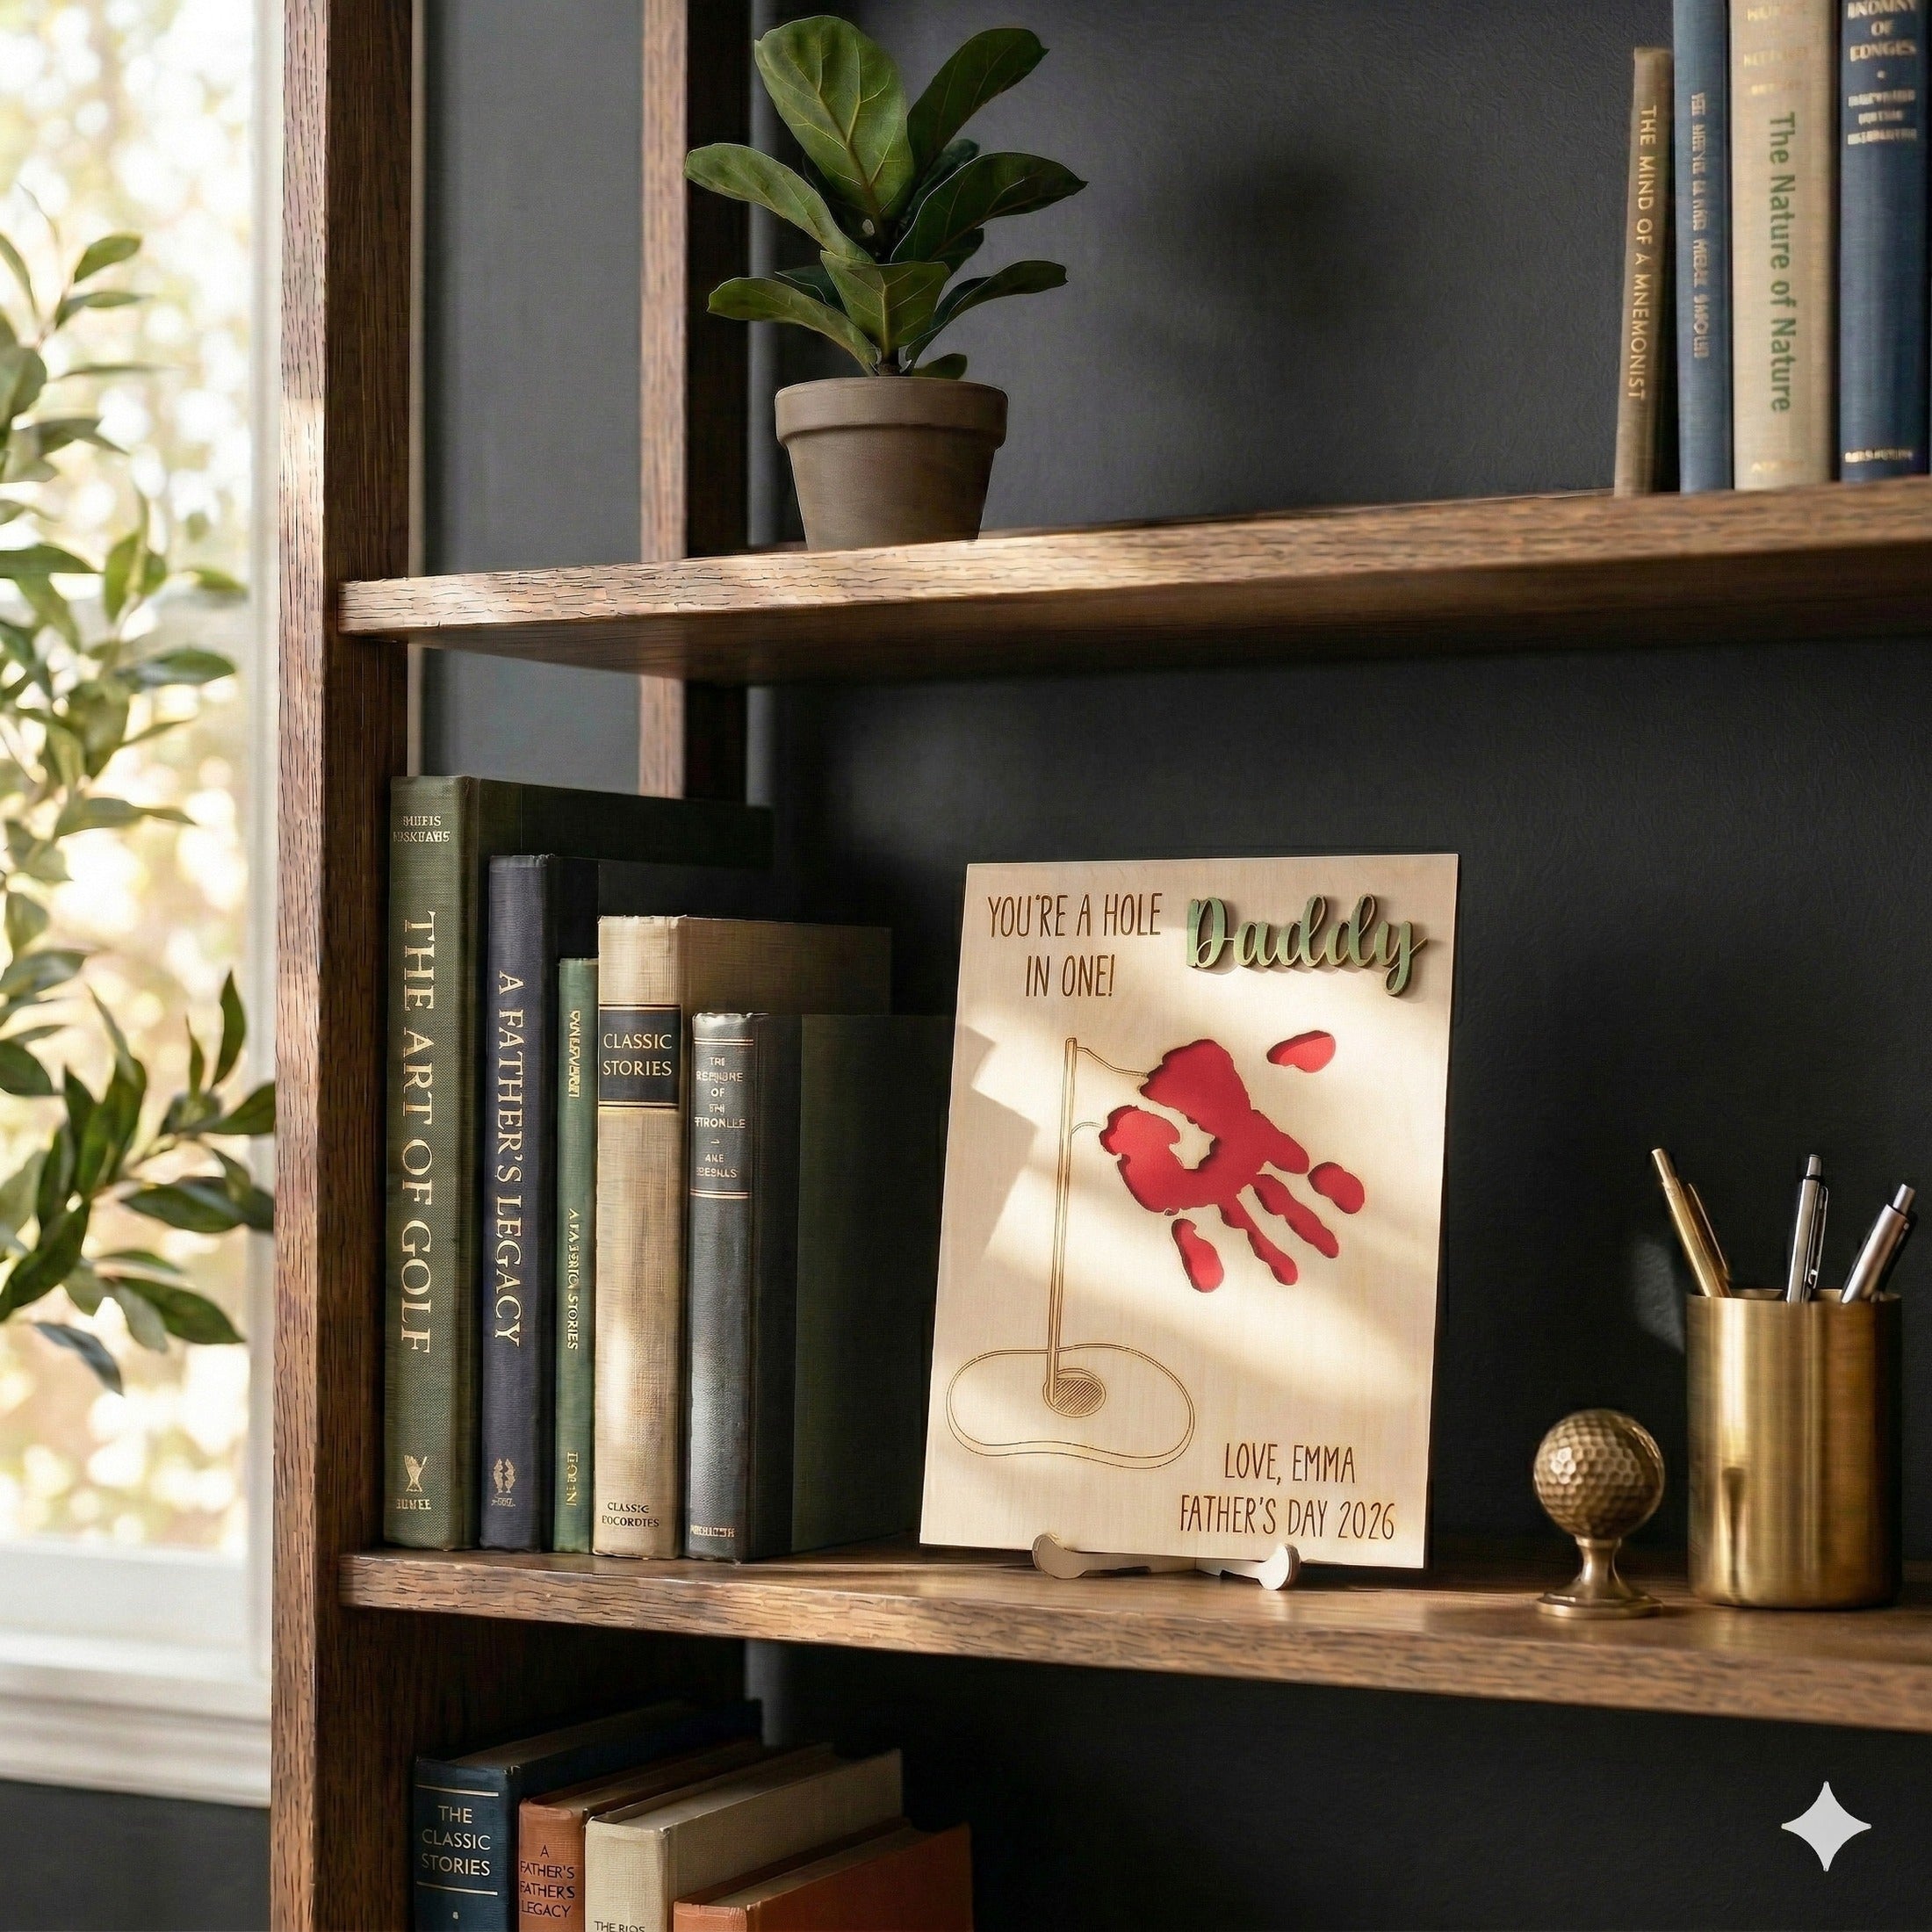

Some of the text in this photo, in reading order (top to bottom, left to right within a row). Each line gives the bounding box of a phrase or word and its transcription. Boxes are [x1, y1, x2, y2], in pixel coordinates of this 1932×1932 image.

[1770, 112, 1796, 164] The
[1770, 174, 1796, 268] Nature
[1628, 105, 1658, 400] THE MIND OF A MNEMONIST
[1771, 278, 1797, 308] of
[1771, 317, 1797, 413] Nature
[988, 892, 1164, 938] YOU'RE A HOLE
[1186, 894, 1428, 998] Daddy
[1026, 954, 1116, 998] IN ONE!
[603, 1033, 673, 1050] CLASSIC
[603, 1059, 673, 1077] STORIES
[710, 1088, 724, 1097] OF
[400, 911, 436, 1353] THE ART OF GOLF
[494, 970, 524, 1347] A FATHER'S LEGACY
[566, 1294, 579, 1351] STORIES
[1224, 1443, 1356, 1485] LOVE, EMMA
[1180, 1495, 1395, 1540] FATHER'S DAY 2026
[438, 1805, 472, 1824] THE
[422, 1828, 491, 1850] CLASSIC
[540, 1844, 550, 1858] A
[422, 1853, 491, 1877] STORIES
[520, 1860, 575, 1879] FATHER'S
[520, 1880, 576, 1900] FATHERS
[521, 1900, 571, 1918] LEGACY
[594, 1921, 616, 1932] THE
